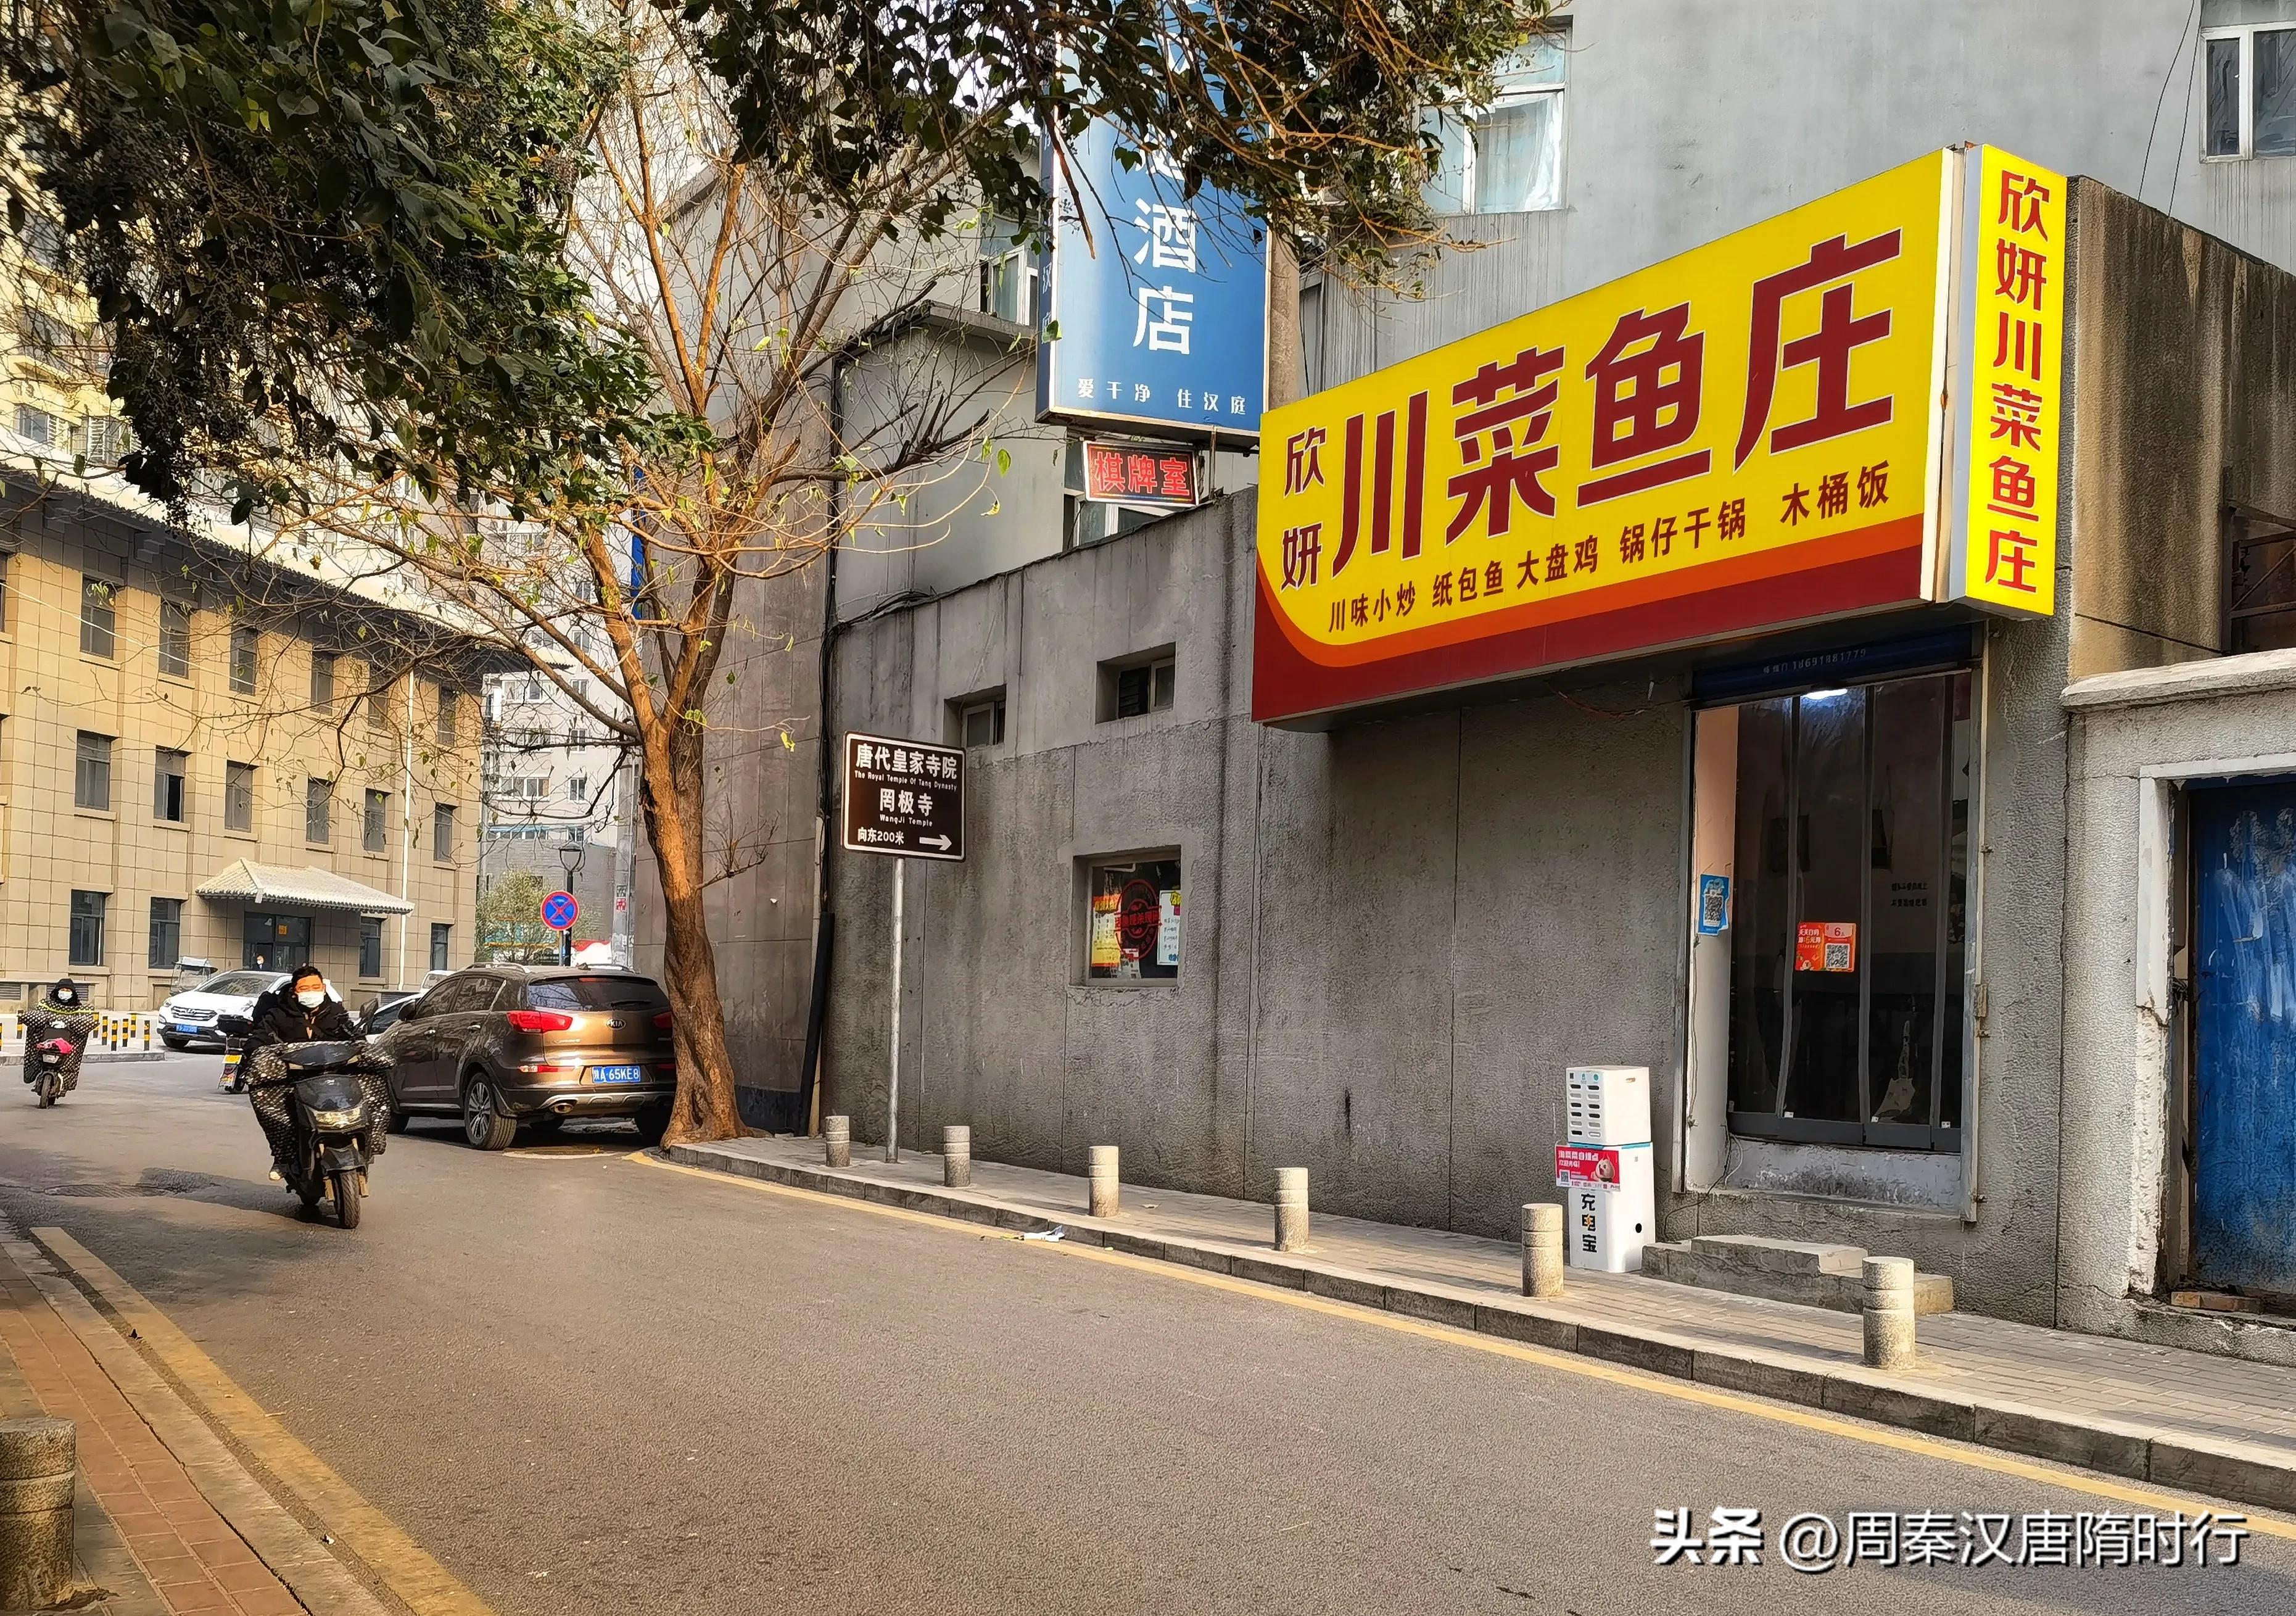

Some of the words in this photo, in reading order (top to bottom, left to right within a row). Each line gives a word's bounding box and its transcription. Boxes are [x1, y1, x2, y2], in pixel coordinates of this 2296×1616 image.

[1078, 377, 1150, 403] 爱干净
[1177, 388, 1247, 415] 住汉庭
[1985, 169, 2050, 594] 欣妍川菜鱼庄
[1332, 226, 1902, 580] 川菜鱼庄
[1094, 450, 1190, 496] 棋牌室
[1281, 426, 1327, 592] 欣妍
[1328, 581, 1416, 633] 川味小炒
[1432, 560, 1505, 608] 纸包鱼
[1516, 534, 1599, 590] 大盘鸡
[1619, 497, 1746, 564] 锅仔干锅
[1780, 460, 1889, 527] 木桶饭
[854, 770, 865, 779] The
[867, 771, 885, 782] Royal
[886, 774, 908, 784] Temple
[910, 777, 917, 785] Of
[919, 779, 931, 789] Tang
[934, 781, 957, 792] Dynasty
[856, 743, 957, 780] 唐代皇家寺院
[880, 787, 933, 817] 罔极寺
[909, 817, 933, 827] Temple
[857, 826, 905, 846] 向东200米
[1580, 1193, 1598, 1254] 充电宝
